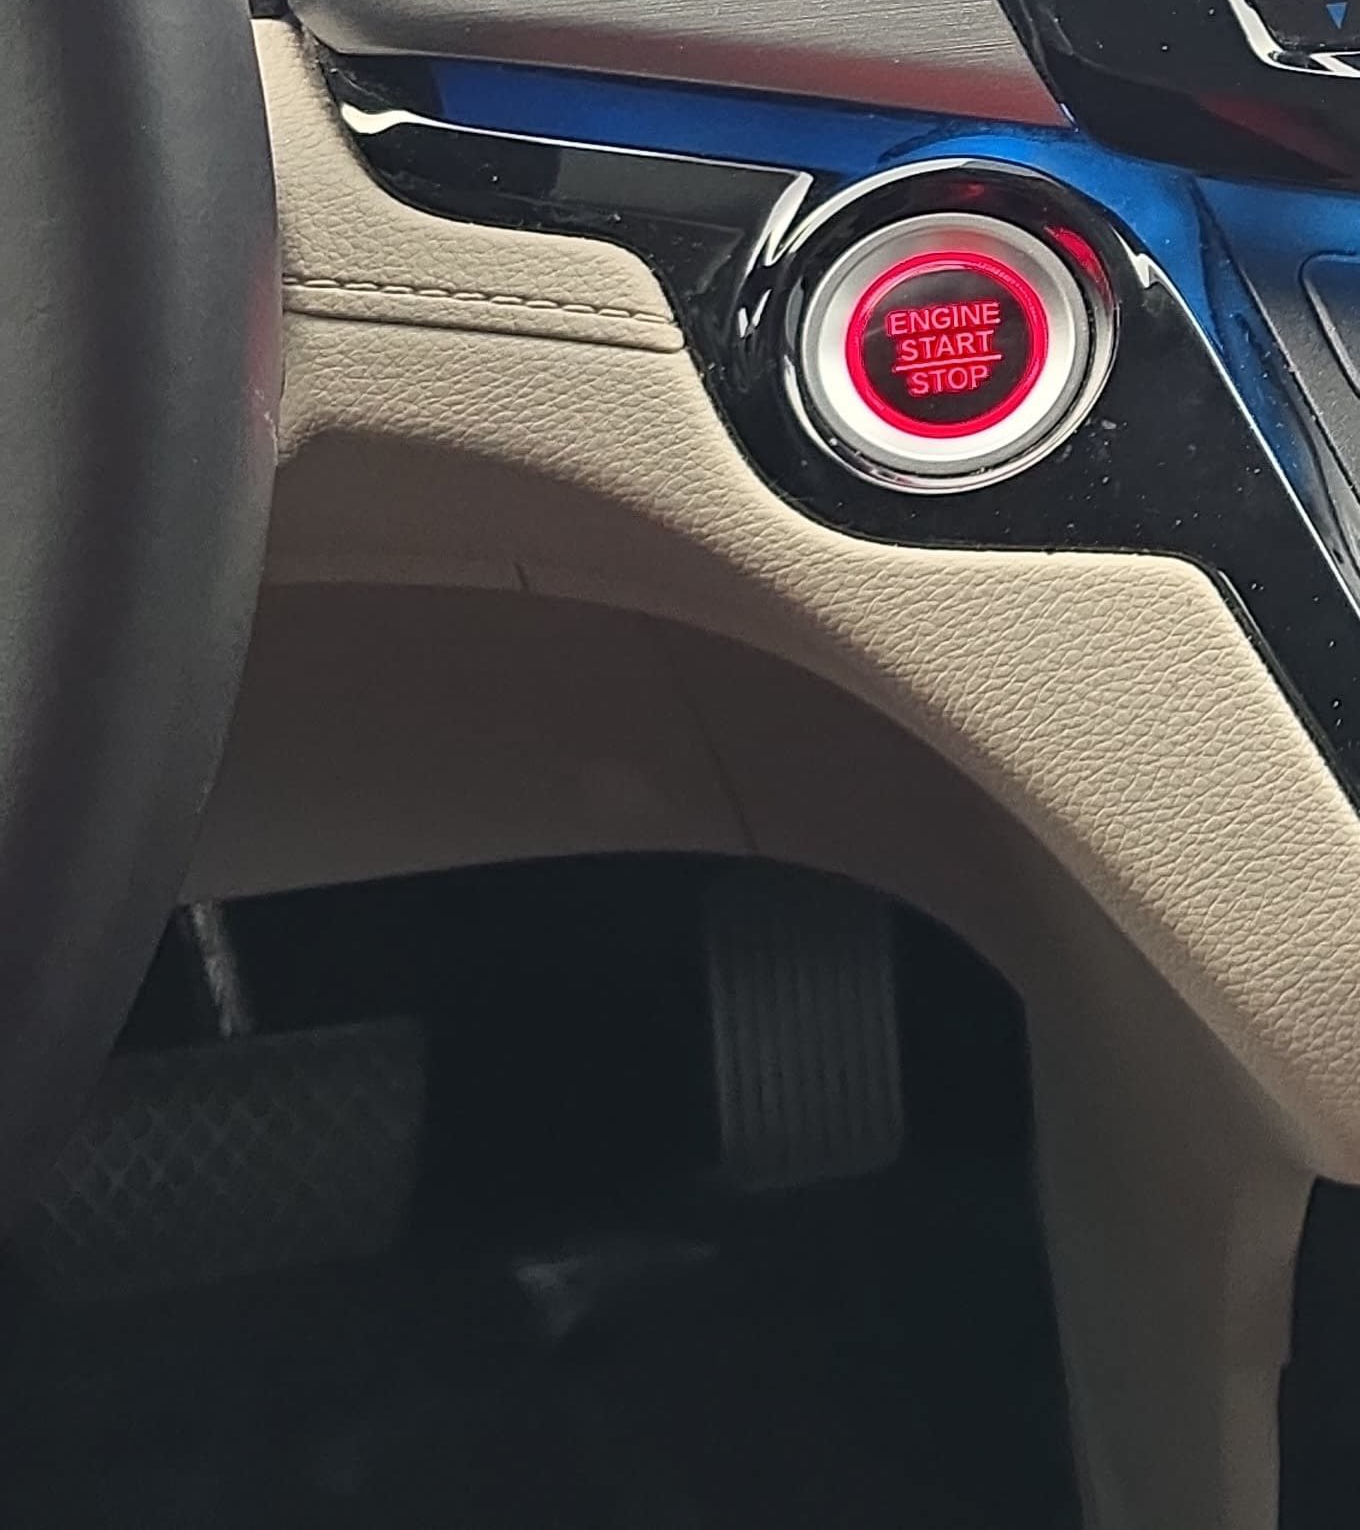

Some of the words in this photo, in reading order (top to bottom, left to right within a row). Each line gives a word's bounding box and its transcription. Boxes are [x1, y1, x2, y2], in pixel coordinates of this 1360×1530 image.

[888, 301, 1000, 335] ENGINE
[900, 329, 995, 361] START
[911, 364, 988, 395] STOP
